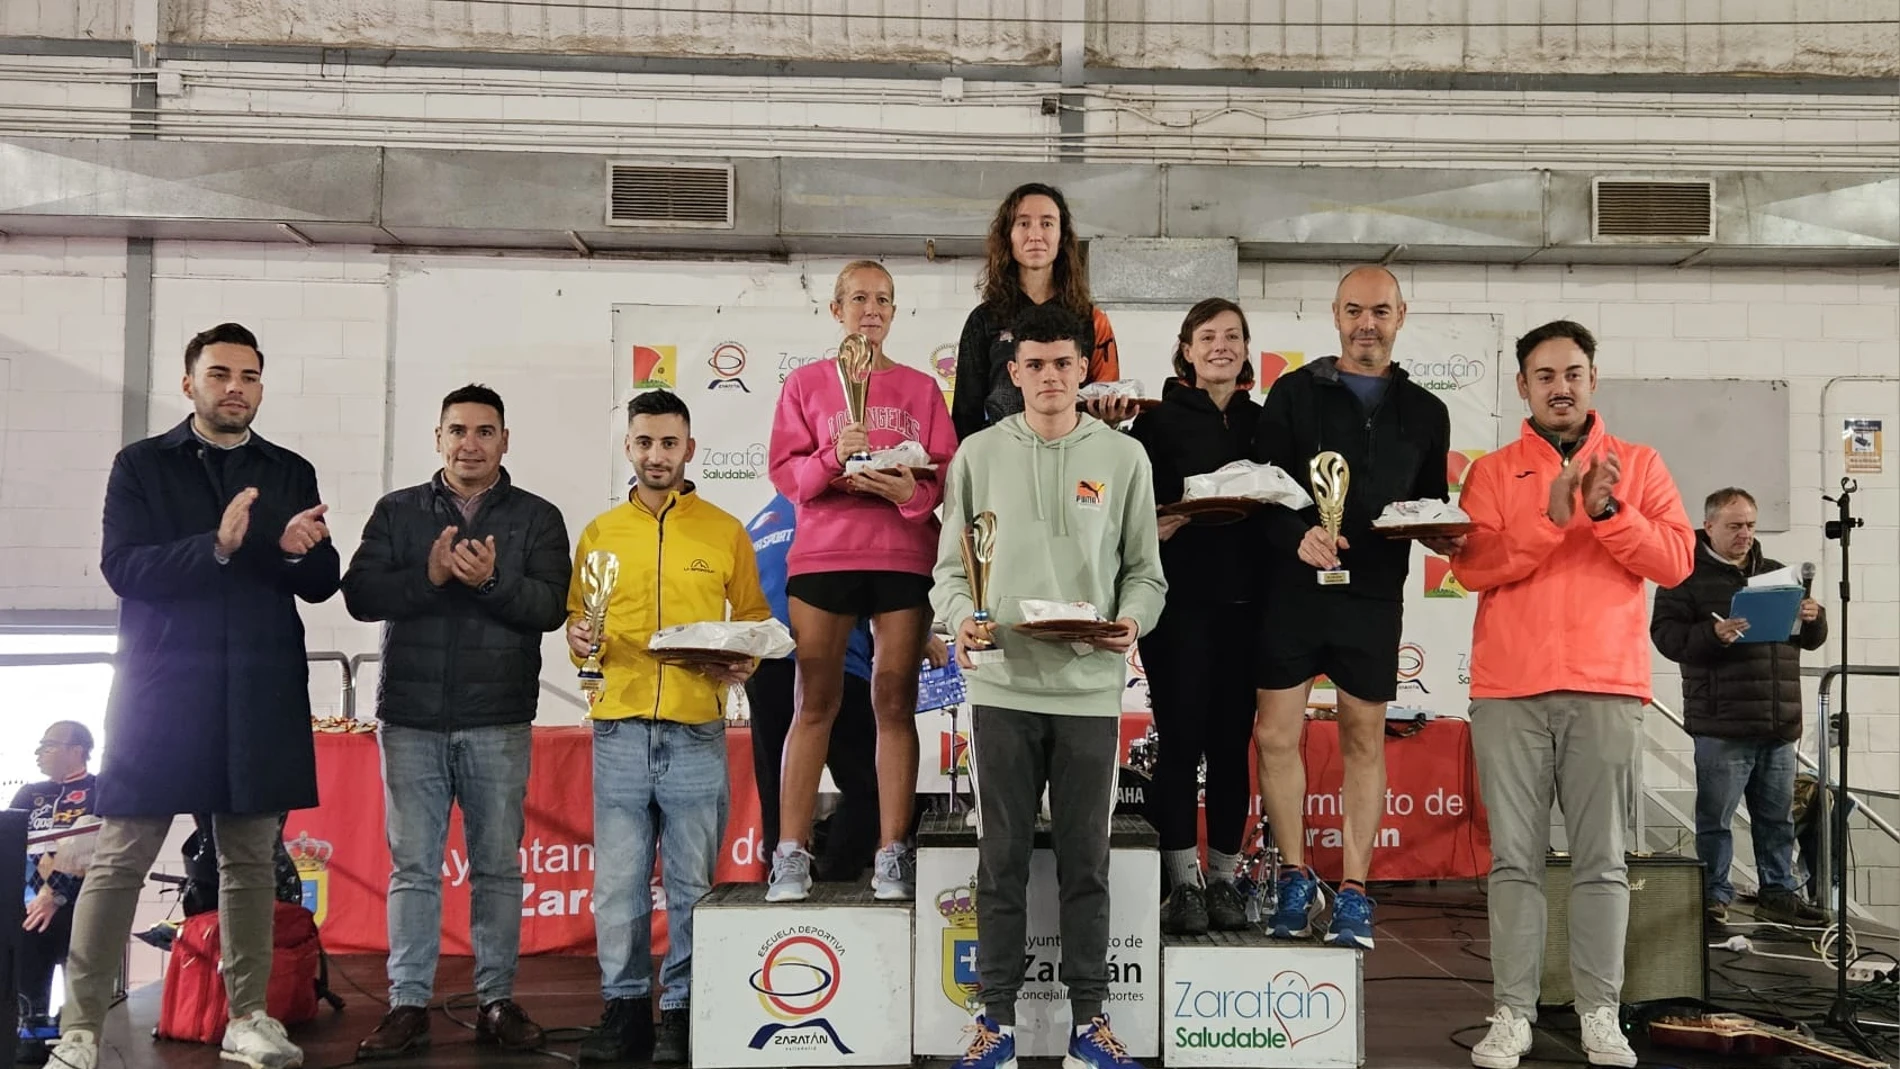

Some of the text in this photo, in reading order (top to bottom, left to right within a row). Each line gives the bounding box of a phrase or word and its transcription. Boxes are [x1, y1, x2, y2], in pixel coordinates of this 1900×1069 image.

[865, 406, 920, 442] NGELES
[702, 447, 766, 466] Zaratá
[702, 469, 756, 479] Saludable
[1424, 787, 1463, 816] de
[758, 926, 846, 958] ESCUELA DEPORTIVA
[1124, 934, 1143, 948] de
[1174, 980, 1330, 1019] Zaratán
[774, 1031, 829, 1045] ZARATÁN
[1175, 1026, 1287, 1049] Saludable
